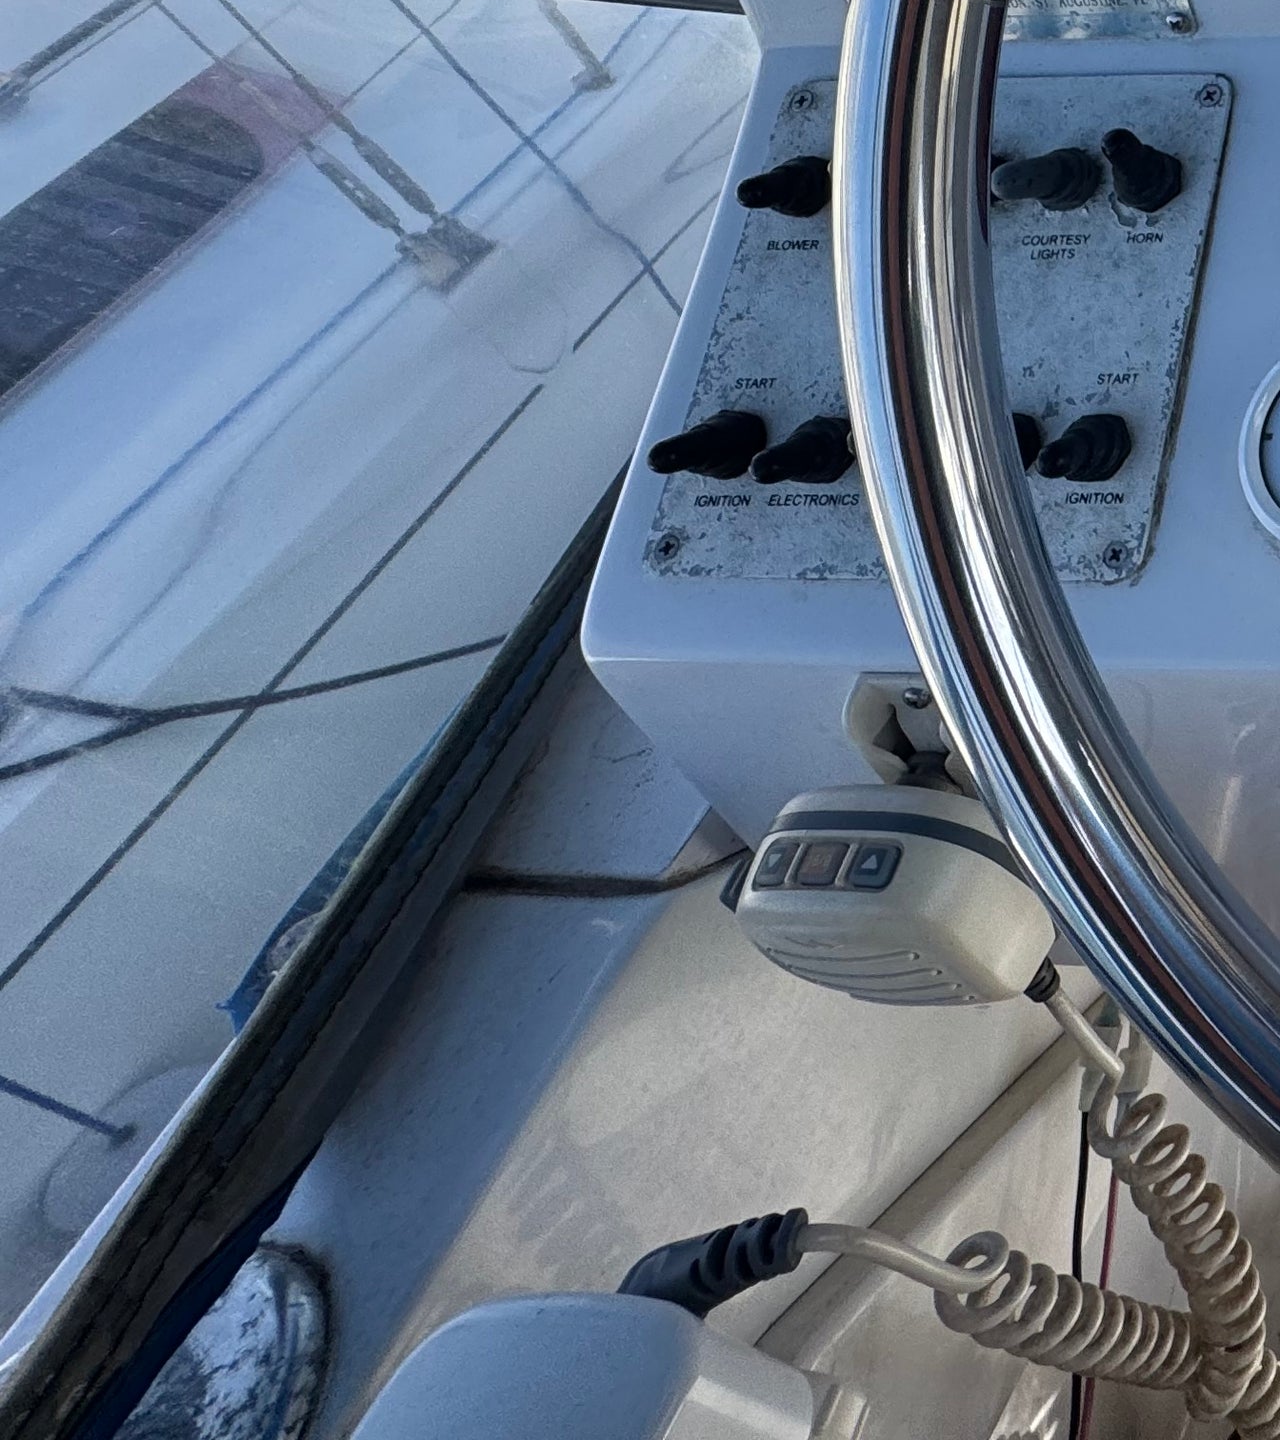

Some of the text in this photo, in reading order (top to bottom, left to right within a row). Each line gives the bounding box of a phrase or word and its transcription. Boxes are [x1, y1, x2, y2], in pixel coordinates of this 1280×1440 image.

[766, 238, 820, 252] BLOWER
[1021, 233, 1092, 247] COURTESY
[1126, 232, 1165, 245] HORN
[1030, 247, 1076, 261] LIGHTS
[735, 377, 778, 390] START
[1096, 372, 1140, 386] START
[694, 494, 752, 509] IGNITION
[768, 494, 861, 508] ELECTRONICS
[1065, 492, 1125, 506] IGNITION
